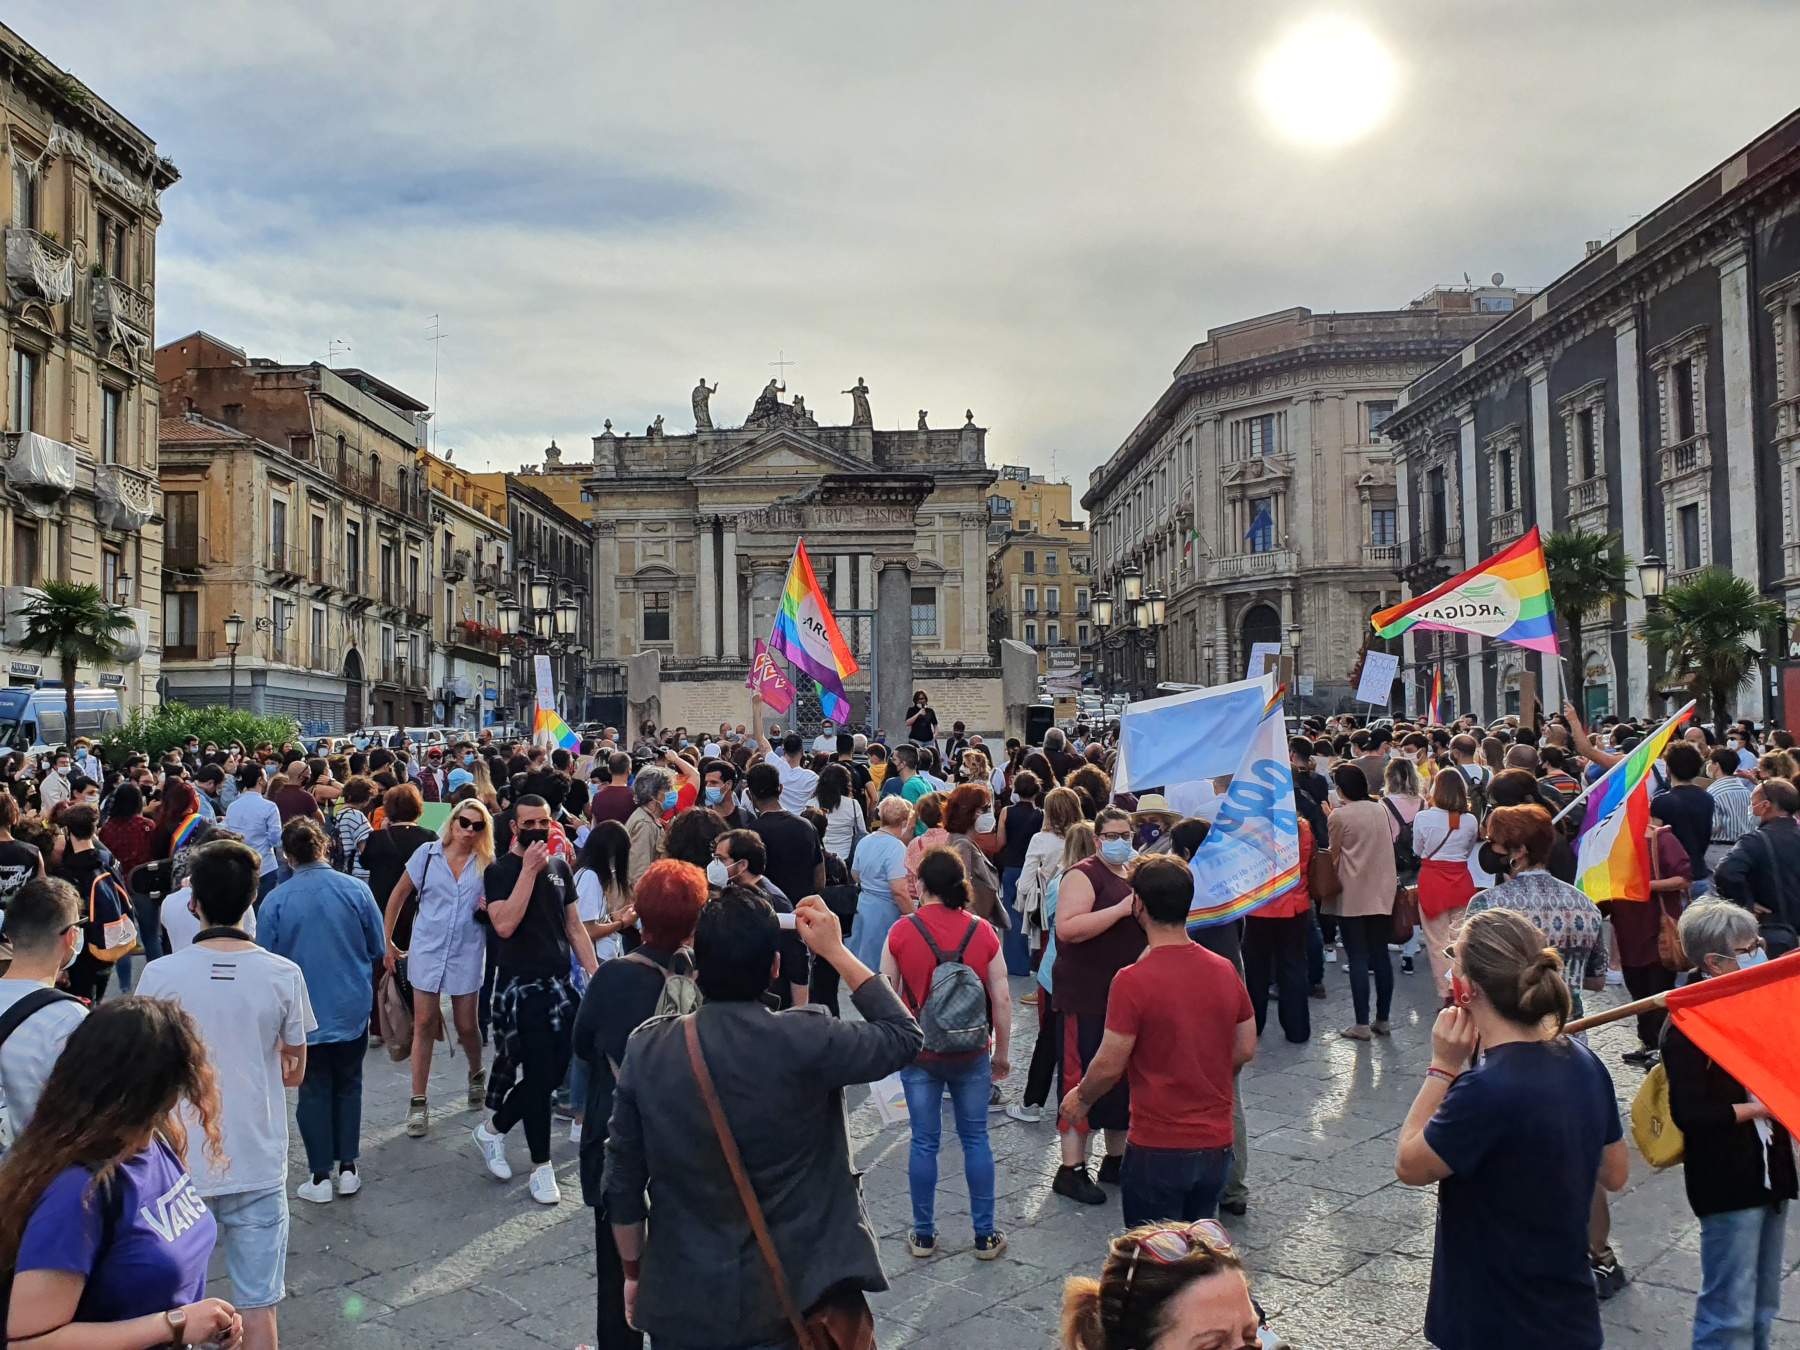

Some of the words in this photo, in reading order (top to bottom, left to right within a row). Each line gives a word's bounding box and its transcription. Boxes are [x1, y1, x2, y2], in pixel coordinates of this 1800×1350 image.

[866, 508, 915, 524] INSIGNE
[802, 616, 830, 643] ARC
[140, 1173, 208, 1243] VANS
